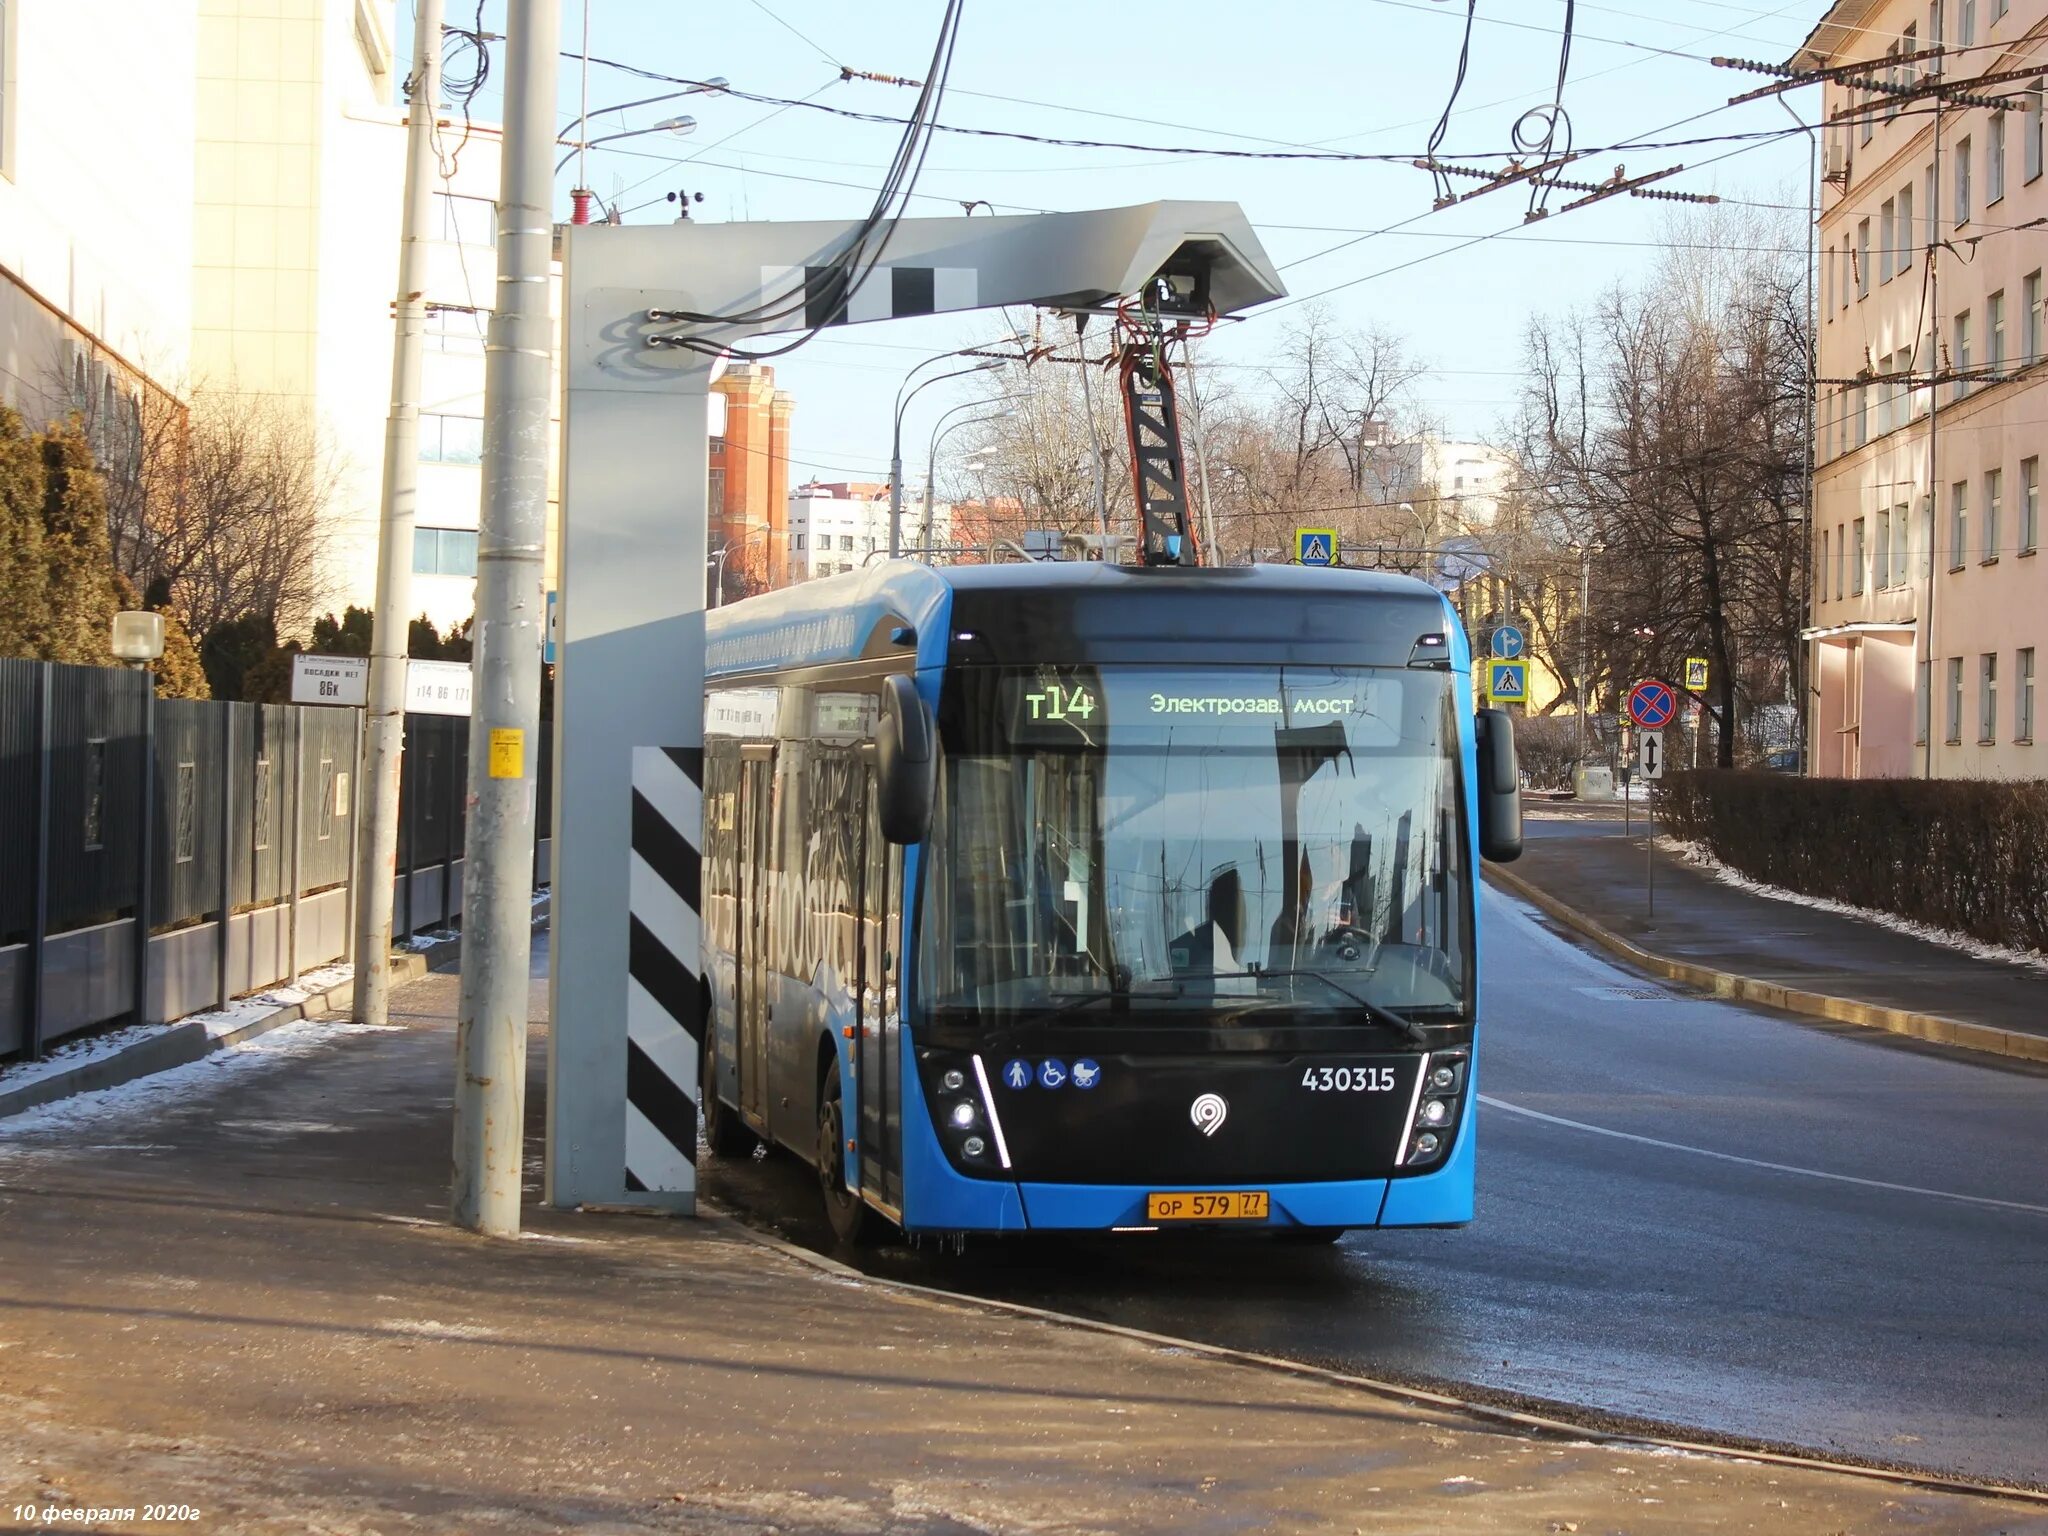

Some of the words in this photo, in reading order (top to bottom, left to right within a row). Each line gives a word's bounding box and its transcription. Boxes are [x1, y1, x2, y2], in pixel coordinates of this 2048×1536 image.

[437, 686, 448, 699] 86
[455, 687, 470, 700] 171
[1025, 686, 1095, 720] т14
[1150, 693, 1284, 715] Электрозав.
[1294, 697, 1356, 715] мост
[1301, 1067, 1395, 1092] 430315
[1158, 1200, 1183, 1216] ОР
[1192, 1195, 1230, 1216] 579
[1241, 1194, 1261, 1209] 77
